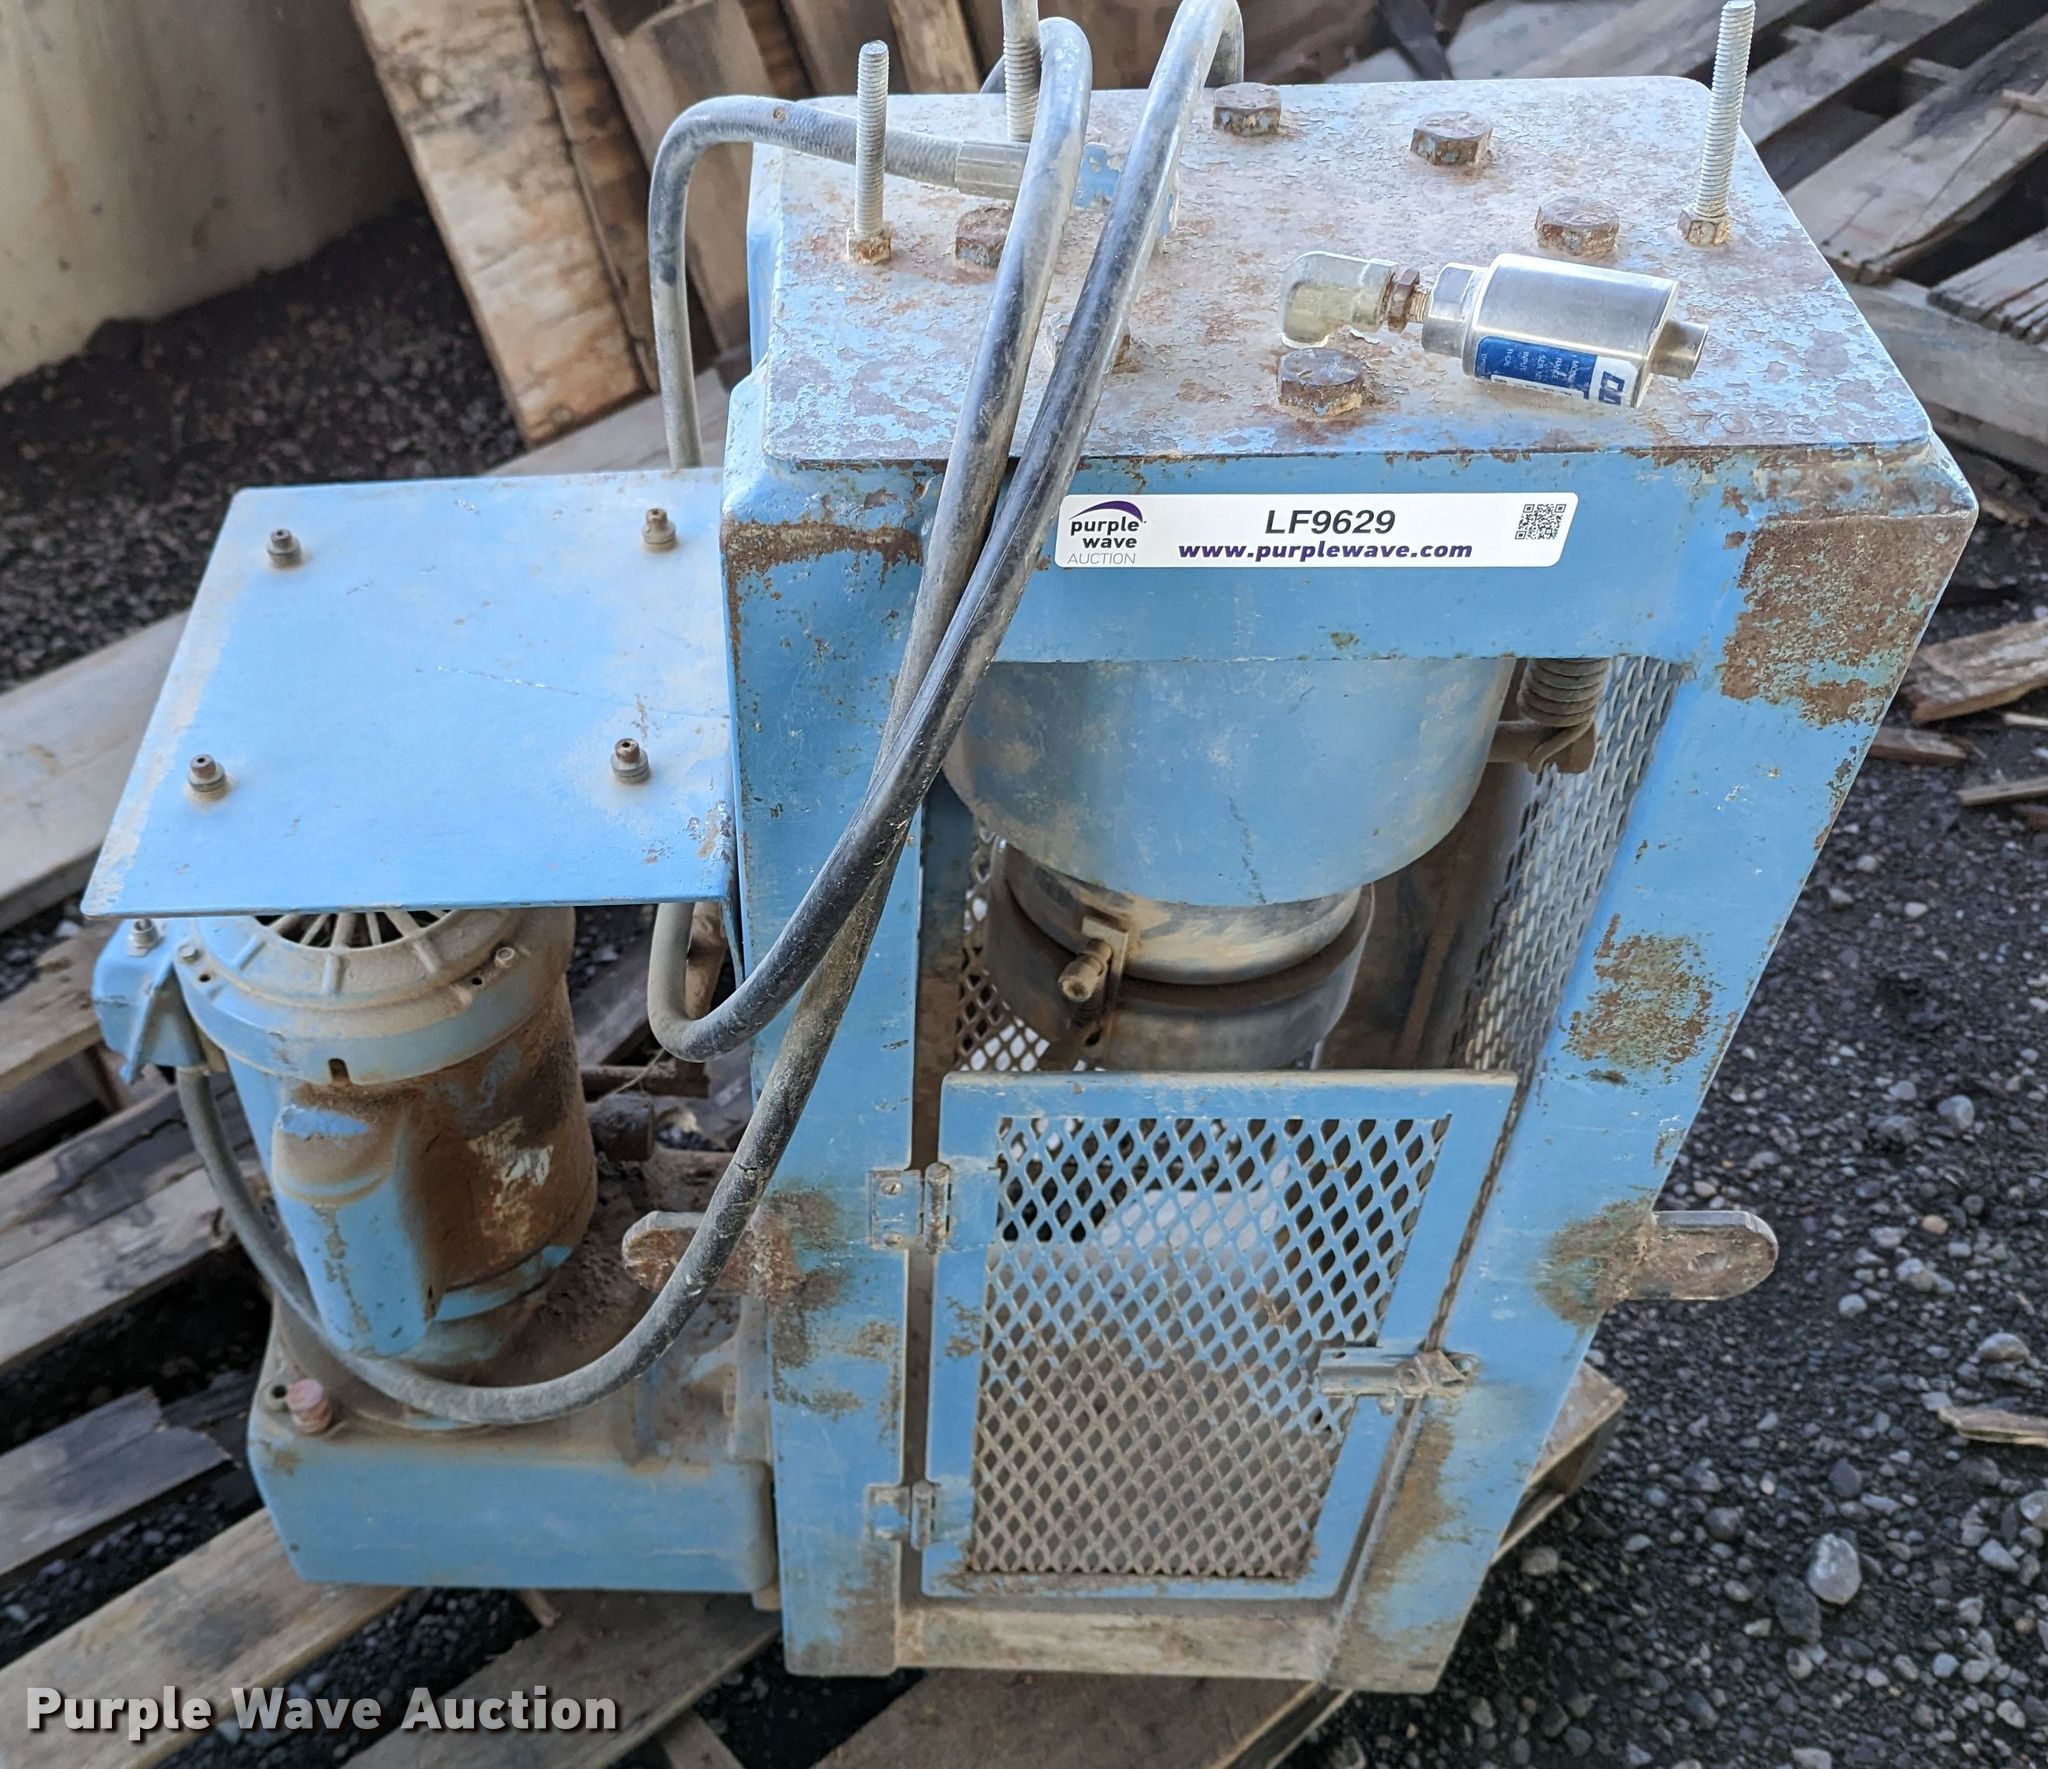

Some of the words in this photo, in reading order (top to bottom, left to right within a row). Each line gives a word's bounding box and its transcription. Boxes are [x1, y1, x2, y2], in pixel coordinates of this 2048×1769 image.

[1069, 519, 1141, 536] purple
[1264, 509, 1397, 535] LF9629
[1082, 537, 1138, 550] wave
[1177, 541, 1473, 563] www.purplewave.com
[1067, 553, 1137, 566] AUCTION
